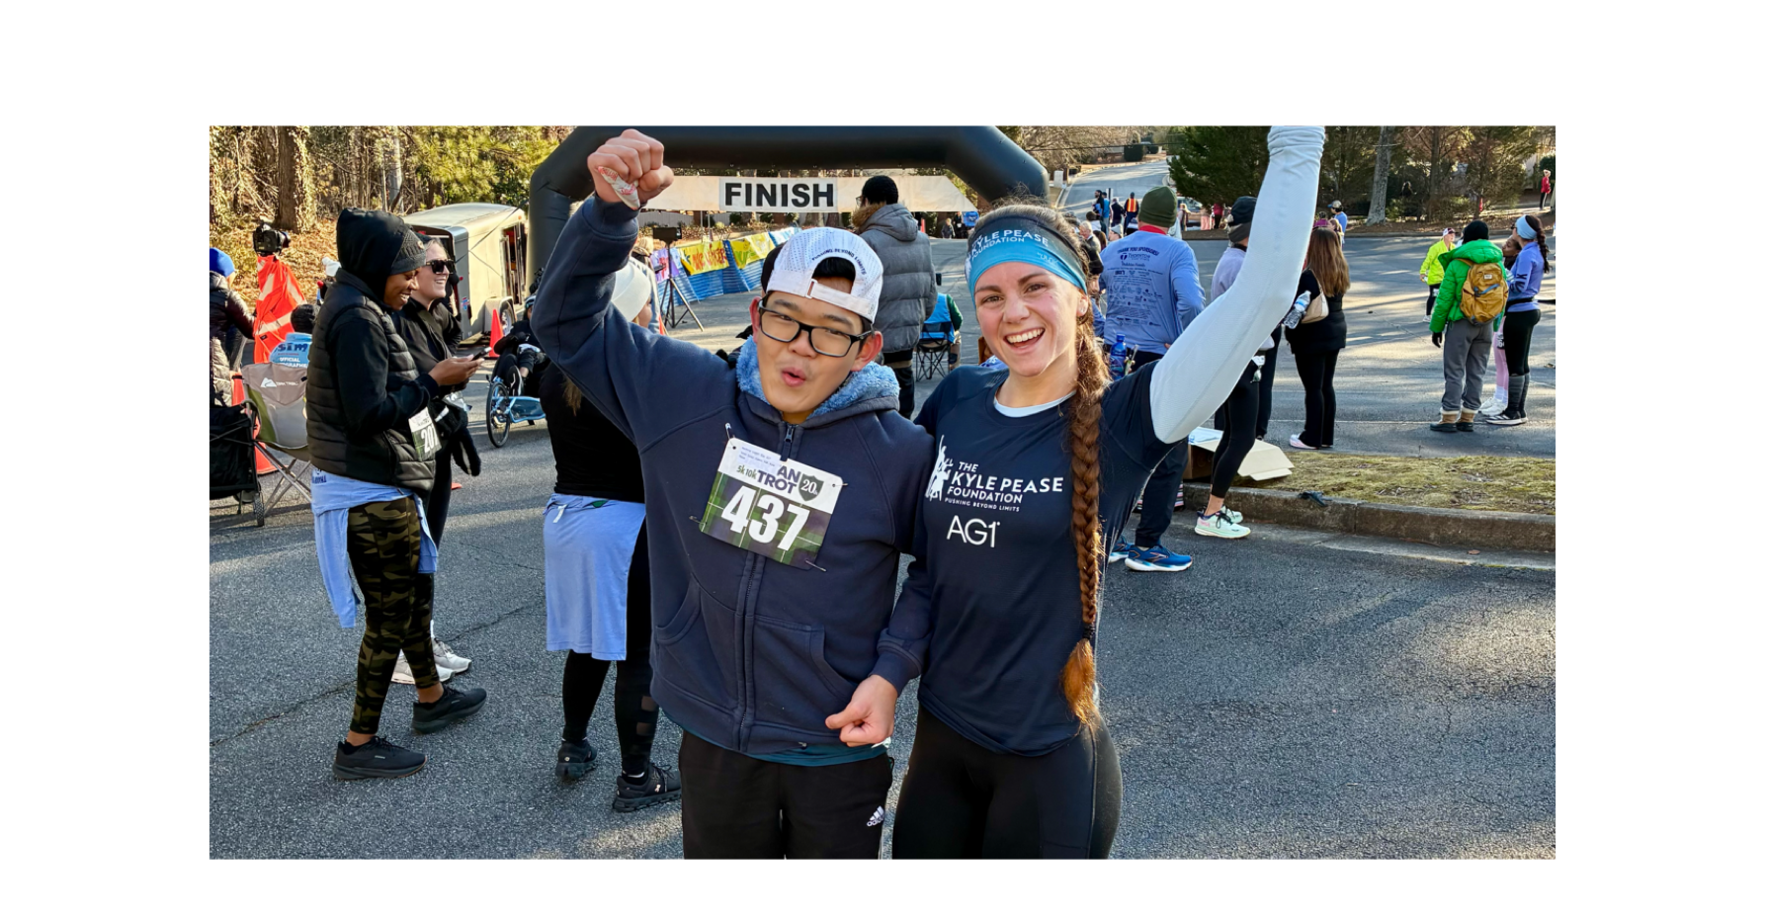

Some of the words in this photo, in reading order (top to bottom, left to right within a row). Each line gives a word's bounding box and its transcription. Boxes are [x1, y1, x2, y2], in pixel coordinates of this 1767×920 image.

[725, 182, 834, 208] FINISH
[1003, 229, 1049, 248] PEASE
[834, 248, 855, 258] BEYOND
[958, 461, 979, 473] THE
[736, 465, 745, 475] 5k
[757, 470, 797, 494] TROT
[951, 471, 998, 491] KYLE
[1000, 477, 1064, 494] PEASE
[944, 497, 971, 506] PUSHING
[972, 501, 998, 510] BEYOND
[947, 486, 1023, 504] FOUNDATION
[721, 485, 811, 551] 437
[946, 515, 998, 548] AG1
